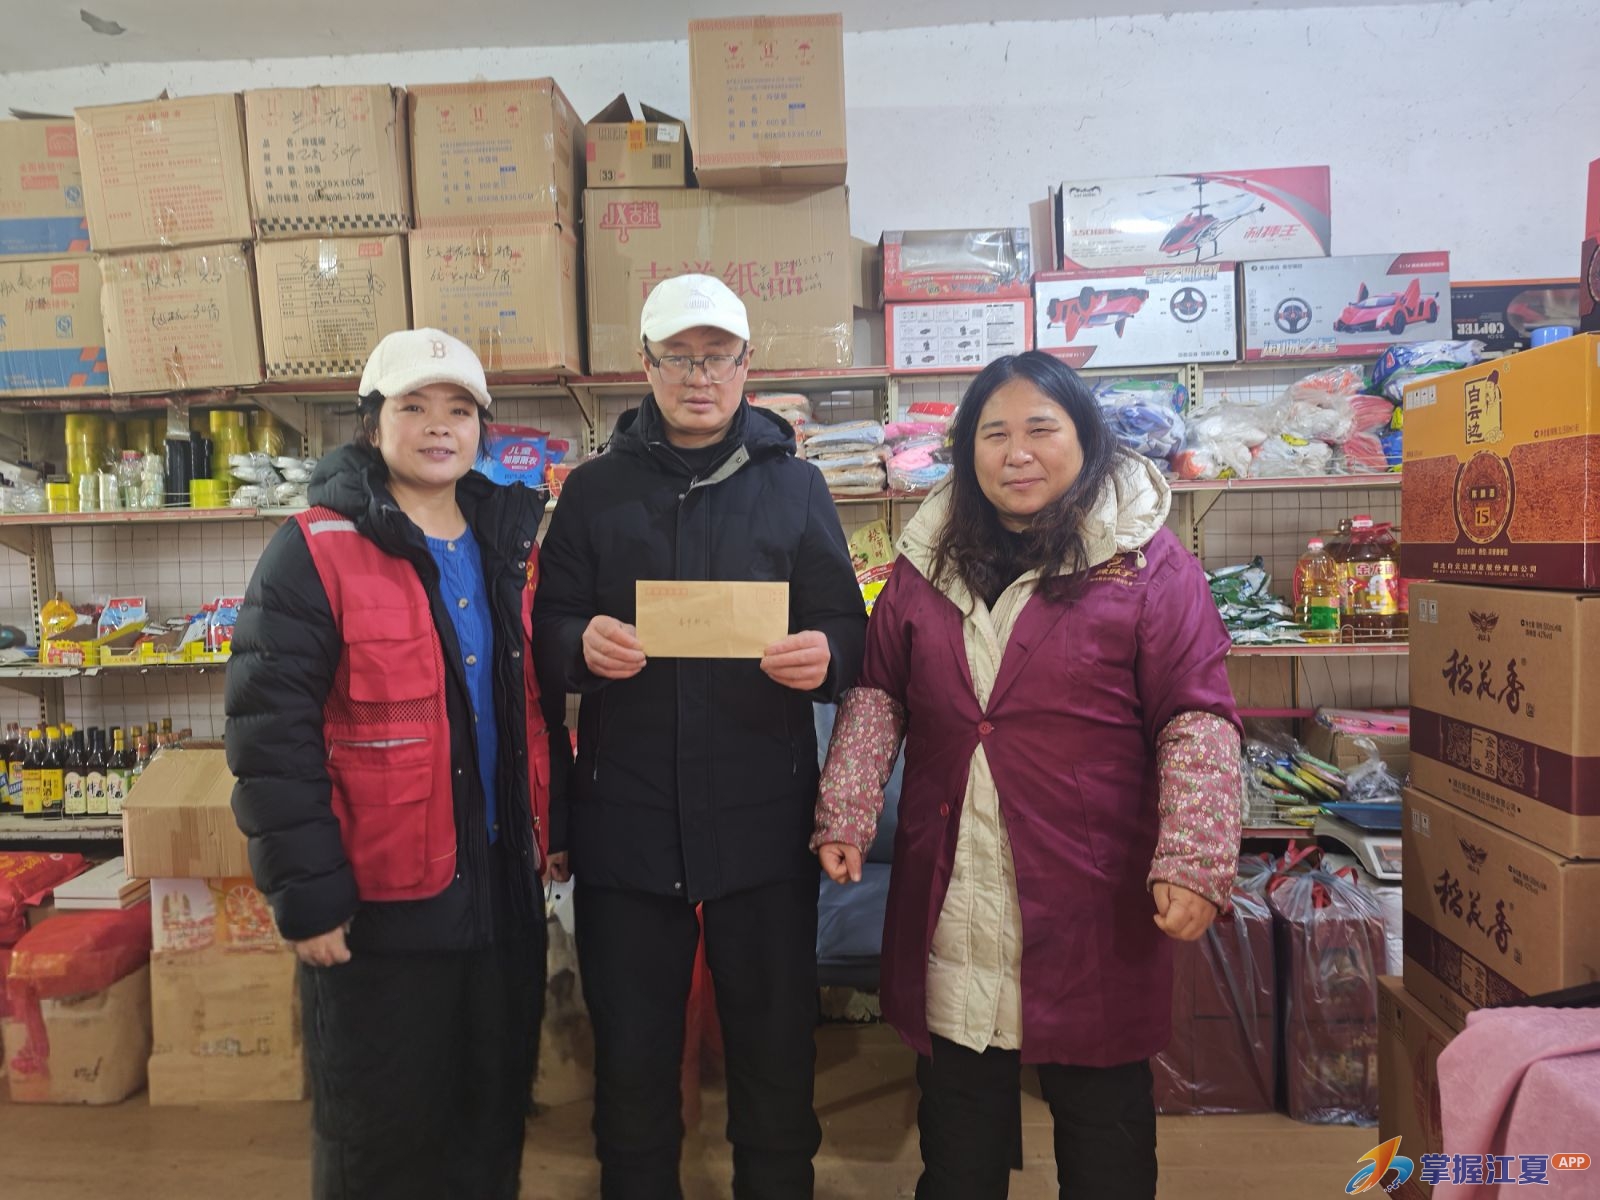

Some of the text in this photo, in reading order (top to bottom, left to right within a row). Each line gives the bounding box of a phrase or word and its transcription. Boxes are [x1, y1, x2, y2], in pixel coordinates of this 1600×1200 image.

[1456, 322, 1504, 335] COPTER
[429, 340, 446, 358] B
[1467, 386, 1483, 438] 白云边
[508, 446, 532, 455] 儿童
[1476, 510, 1489, 524] 15
[1442, 649, 1525, 714] 稻花香
